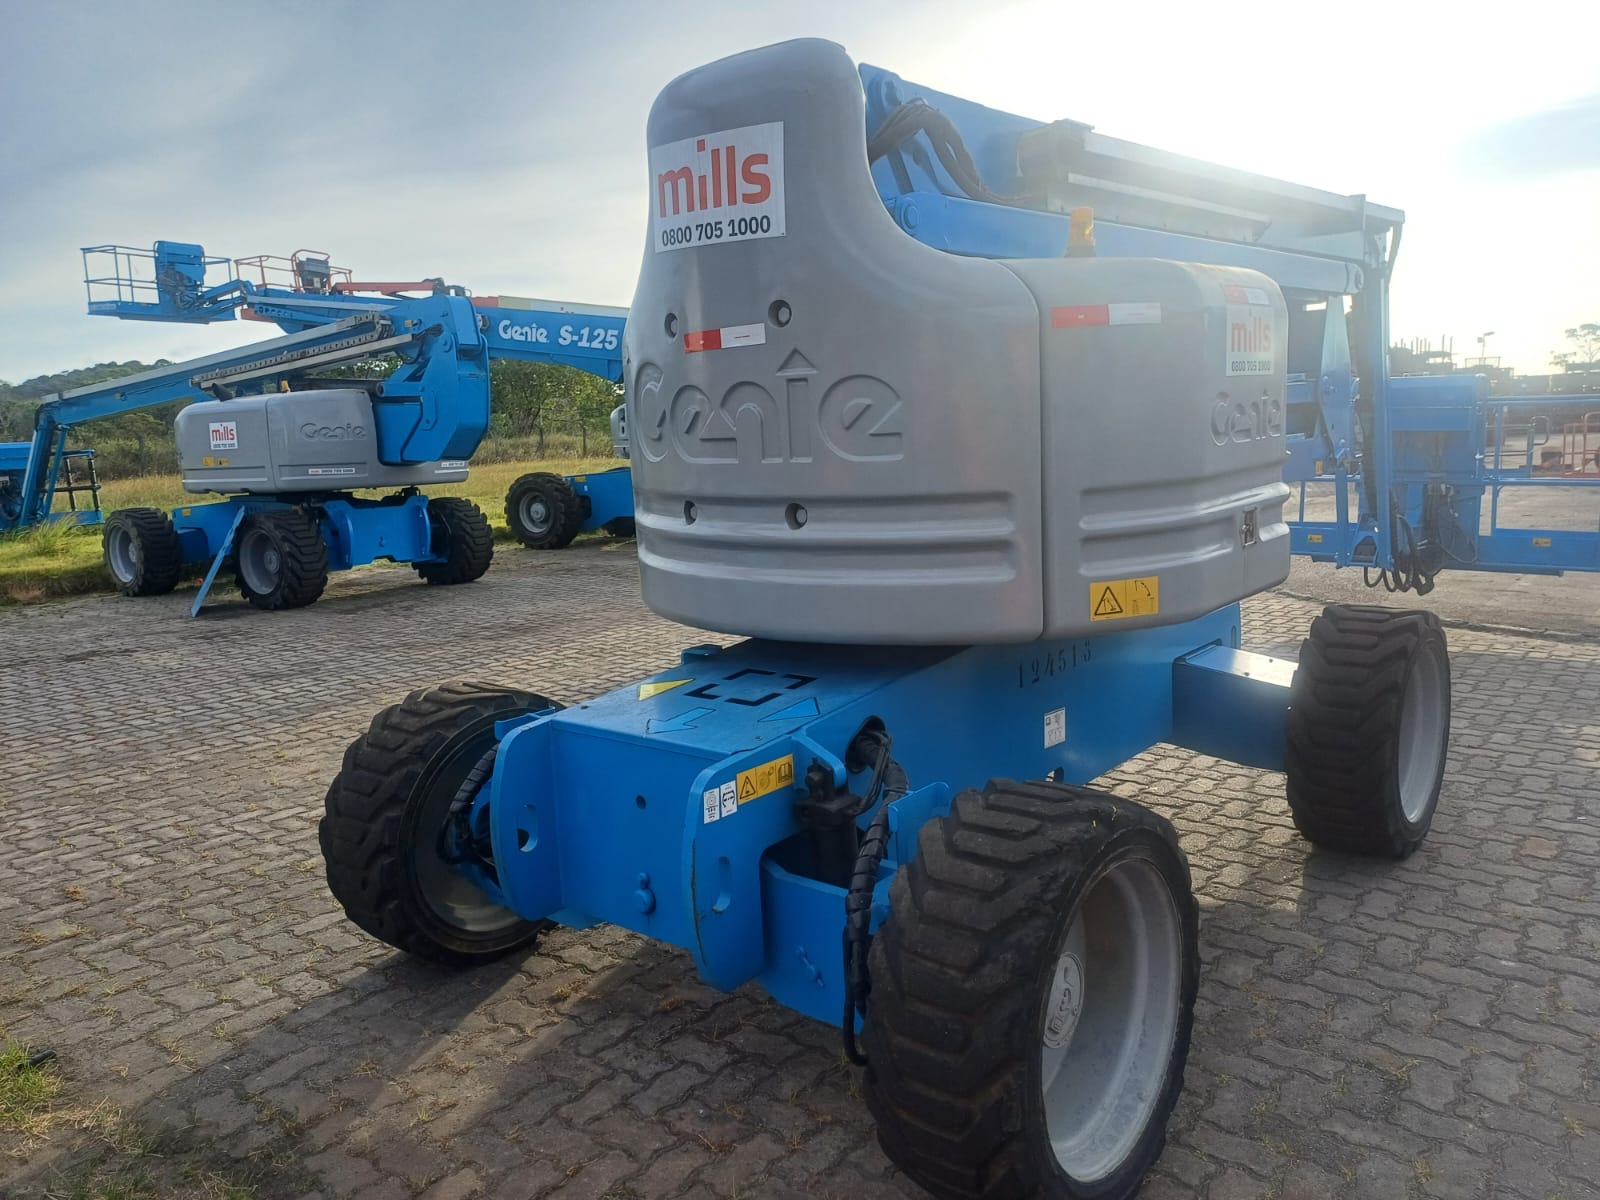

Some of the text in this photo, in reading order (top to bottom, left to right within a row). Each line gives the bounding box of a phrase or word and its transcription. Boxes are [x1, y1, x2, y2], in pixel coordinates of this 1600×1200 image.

[658, 139, 771, 218] mills
[662, 215, 771, 247] 0800 705 1000
[498, 319, 619, 350] Genie S-125
[1231, 309, 1271, 352] mills
[634, 348, 904, 463] Genie
[211, 423, 235, 442] mills
[300, 422, 368, 441] Genie
